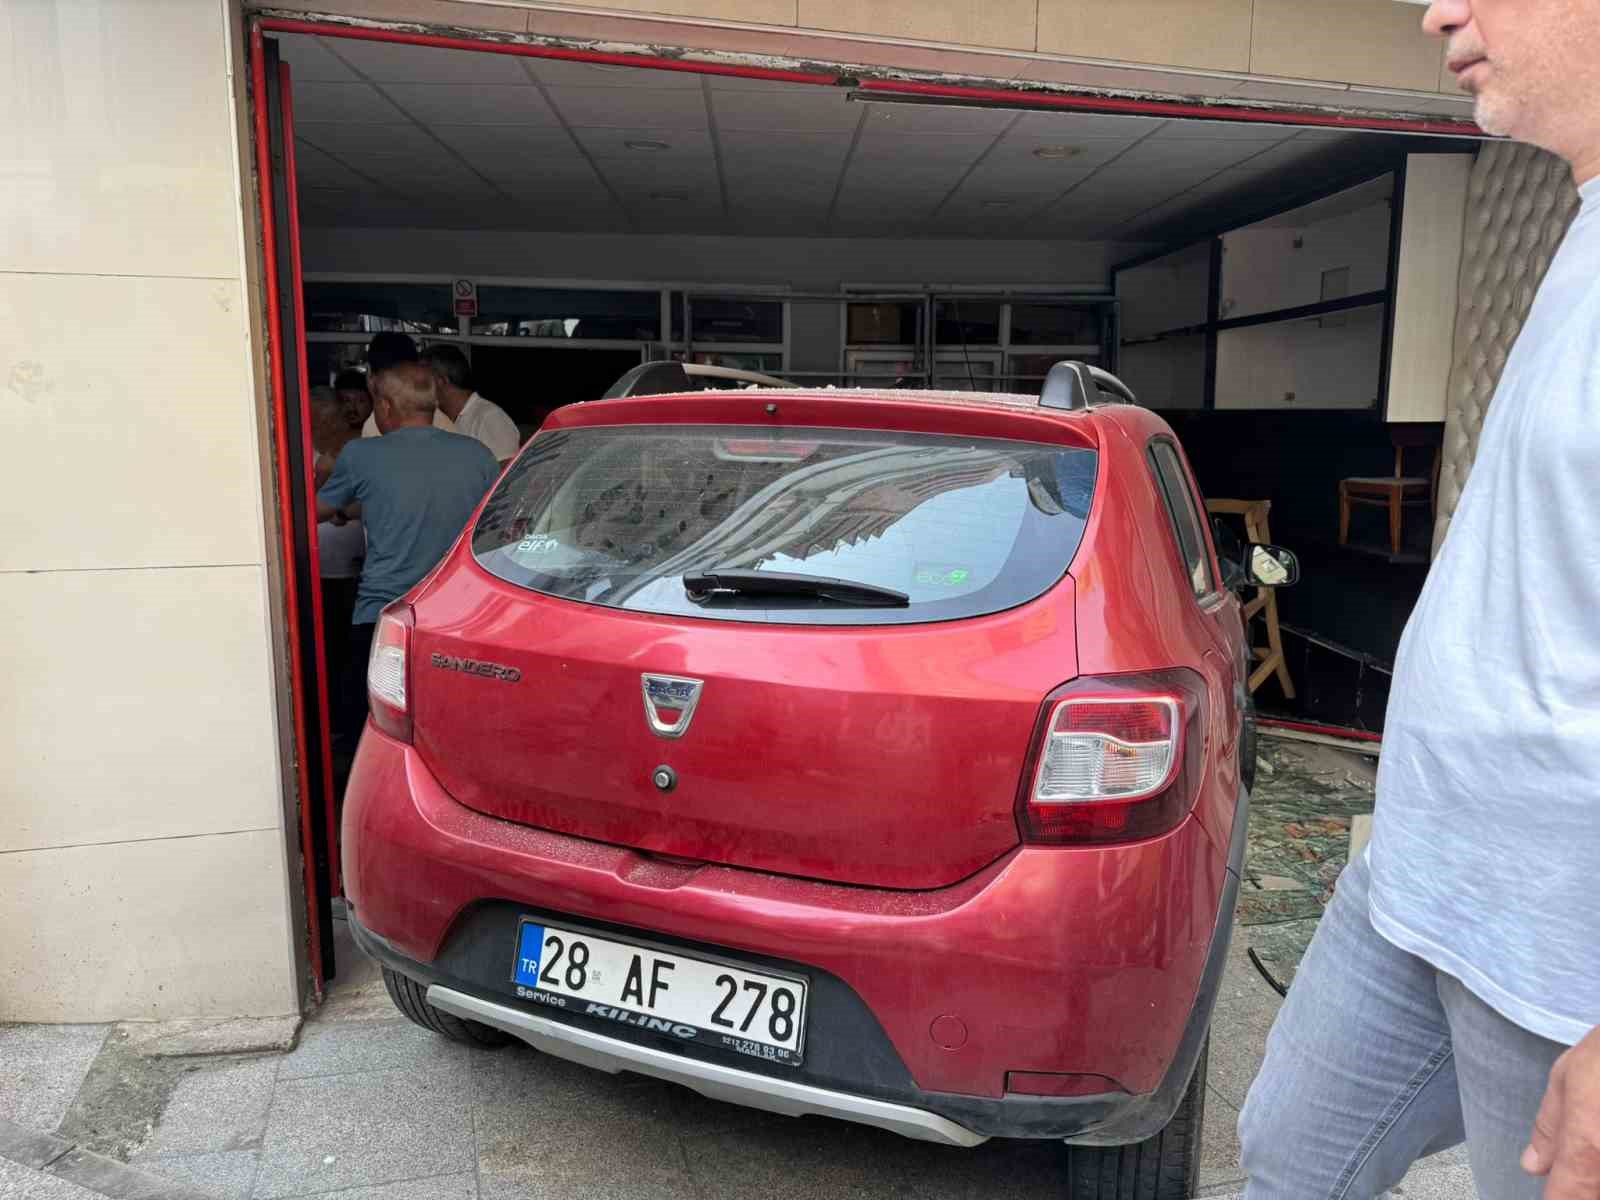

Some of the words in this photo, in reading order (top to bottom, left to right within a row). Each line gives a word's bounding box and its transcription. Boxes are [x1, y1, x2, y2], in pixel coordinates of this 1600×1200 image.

[432, 652, 522, 682] SANDERO
[521, 958, 537, 975] TR
[517, 986, 567, 1008] Service
[540, 936, 589, 990] 28
[620, 954, 675, 1008] AF
[711, 974, 796, 1042] 278
